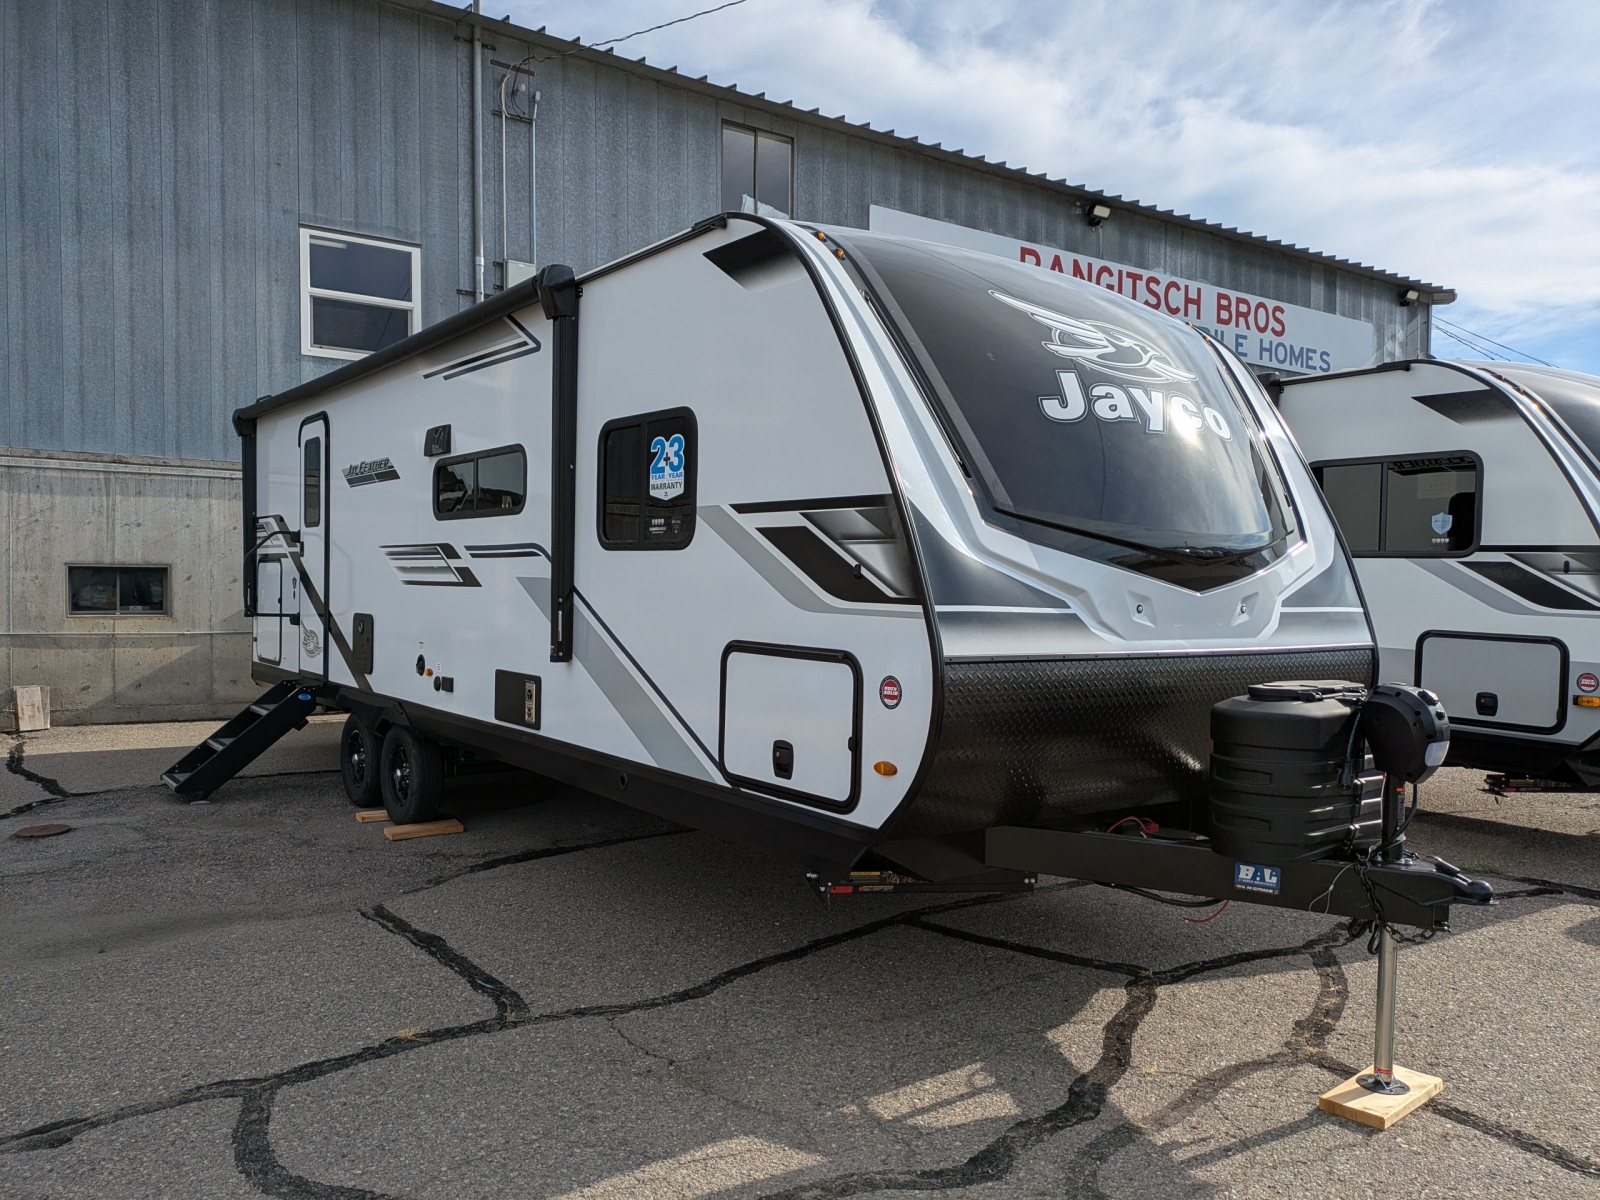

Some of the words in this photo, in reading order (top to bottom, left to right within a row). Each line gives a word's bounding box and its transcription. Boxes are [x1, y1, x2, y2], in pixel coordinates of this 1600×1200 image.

[1216, 291, 1286, 338] BROS
[1259, 338, 1331, 373] HOMES
[1038, 369, 1232, 441] Jayco
[651, 481, 683, 491] WARRANTY
[668, 471, 683, 479] YEAR
